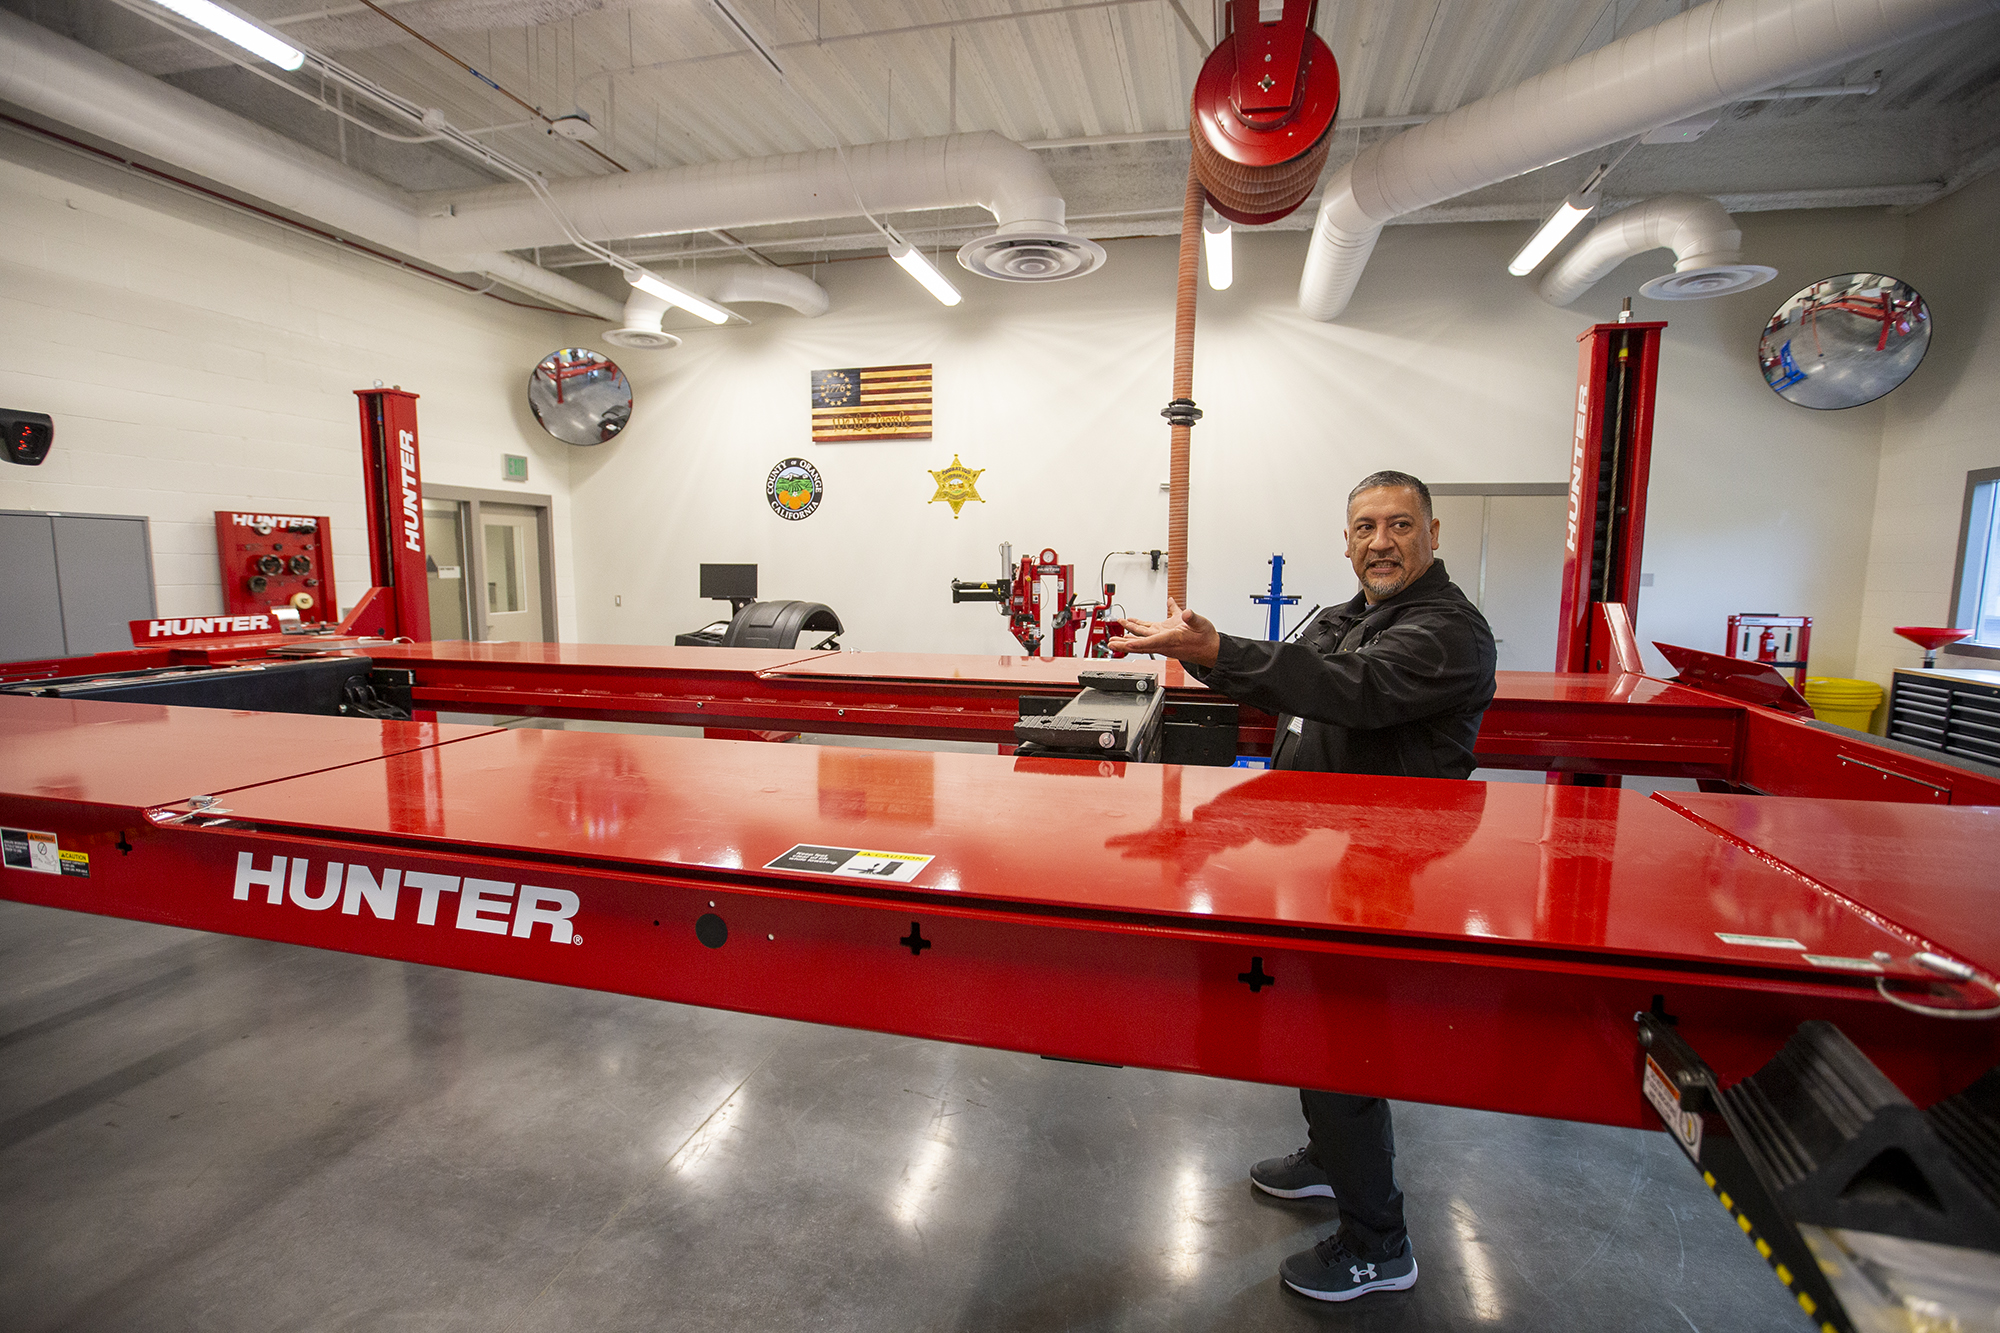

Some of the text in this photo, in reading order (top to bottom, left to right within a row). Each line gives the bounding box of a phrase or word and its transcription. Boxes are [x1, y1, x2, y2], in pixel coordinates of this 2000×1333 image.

[826, 384, 845, 393] 1776
[767, 461, 787, 495] COUNTY
[799, 460, 822, 493] ORANGE
[1567, 384, 1588, 552] HUNTER
[399, 429, 421, 552] HUNTER
[771, 501, 819, 520] CALIFORNIA
[232, 513, 317, 529] HUNTER
[149, 615, 270, 637] HUNTER
[65, 852, 87, 861] CAUTION
[875, 853, 924, 861] CAUTION
